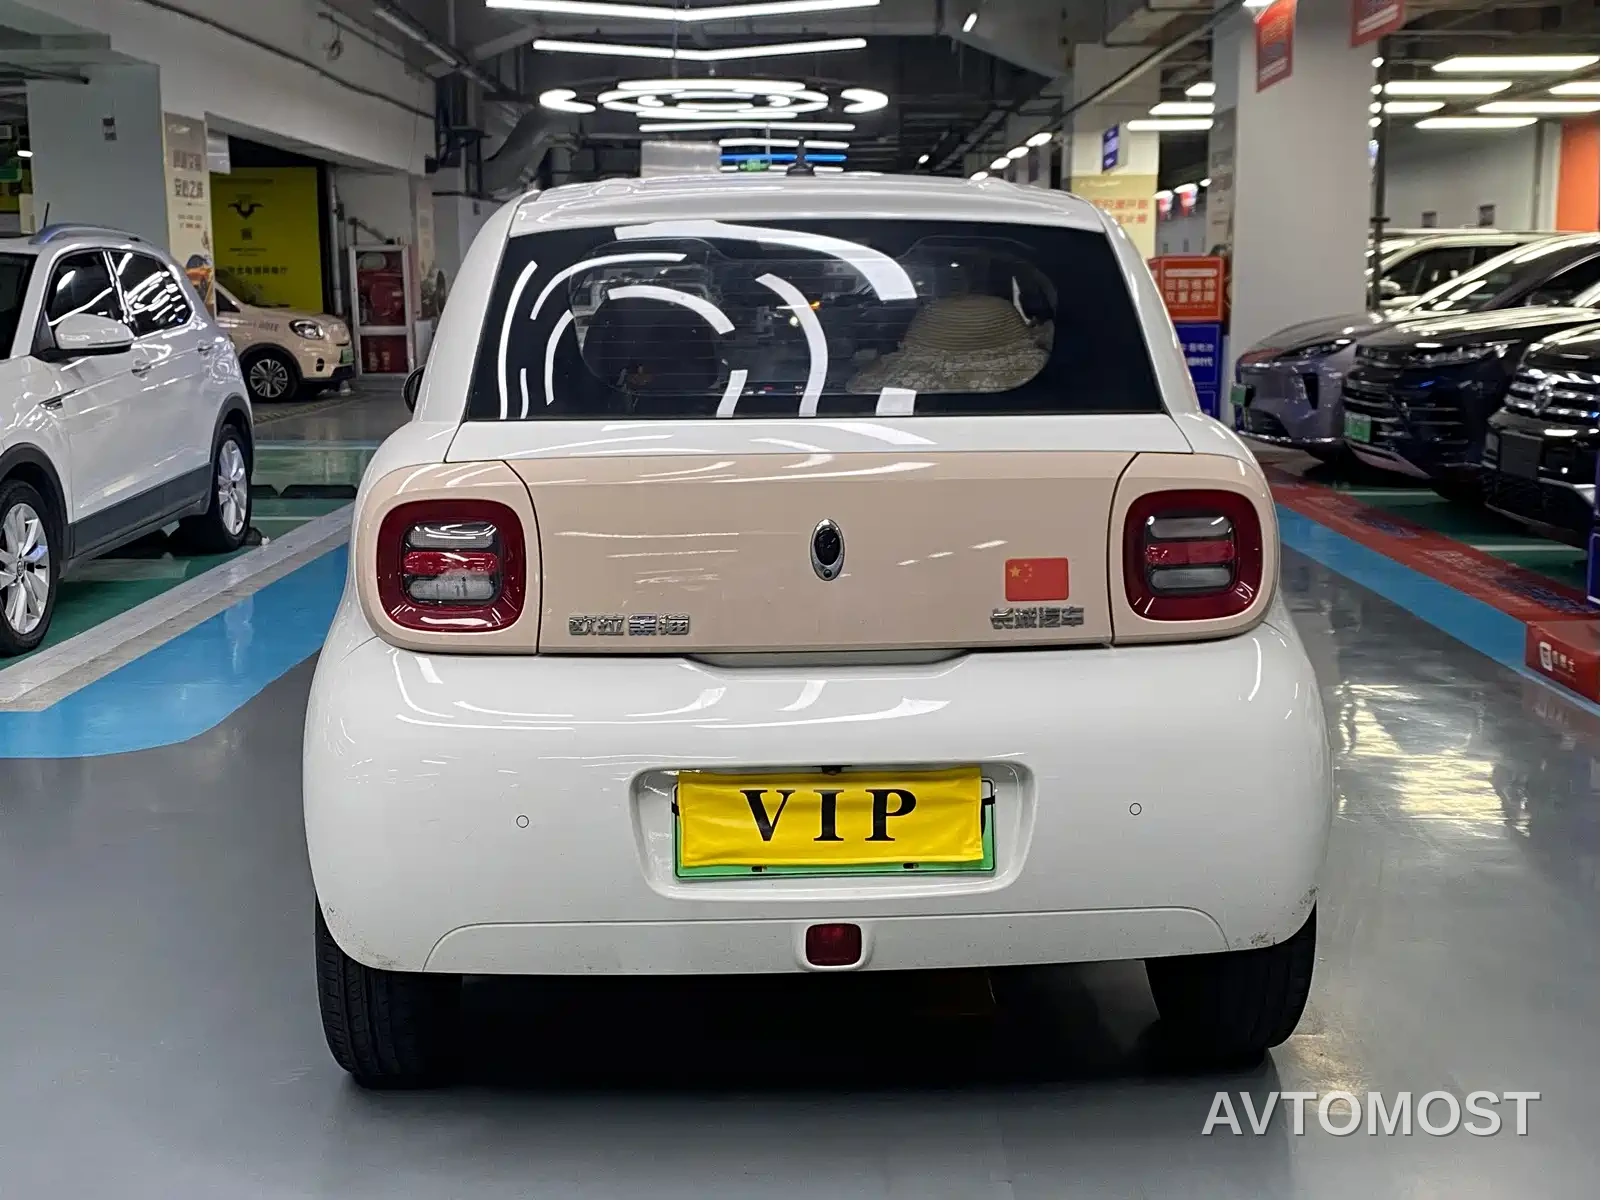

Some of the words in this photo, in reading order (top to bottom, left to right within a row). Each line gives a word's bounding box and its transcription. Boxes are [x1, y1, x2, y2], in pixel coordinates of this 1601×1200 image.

[569, 614, 624, 636] 欧拉
[628, 613, 690, 636] 黑猫
[990, 606, 1085, 630] 长城汽车
[740, 788, 917, 842] VIP
